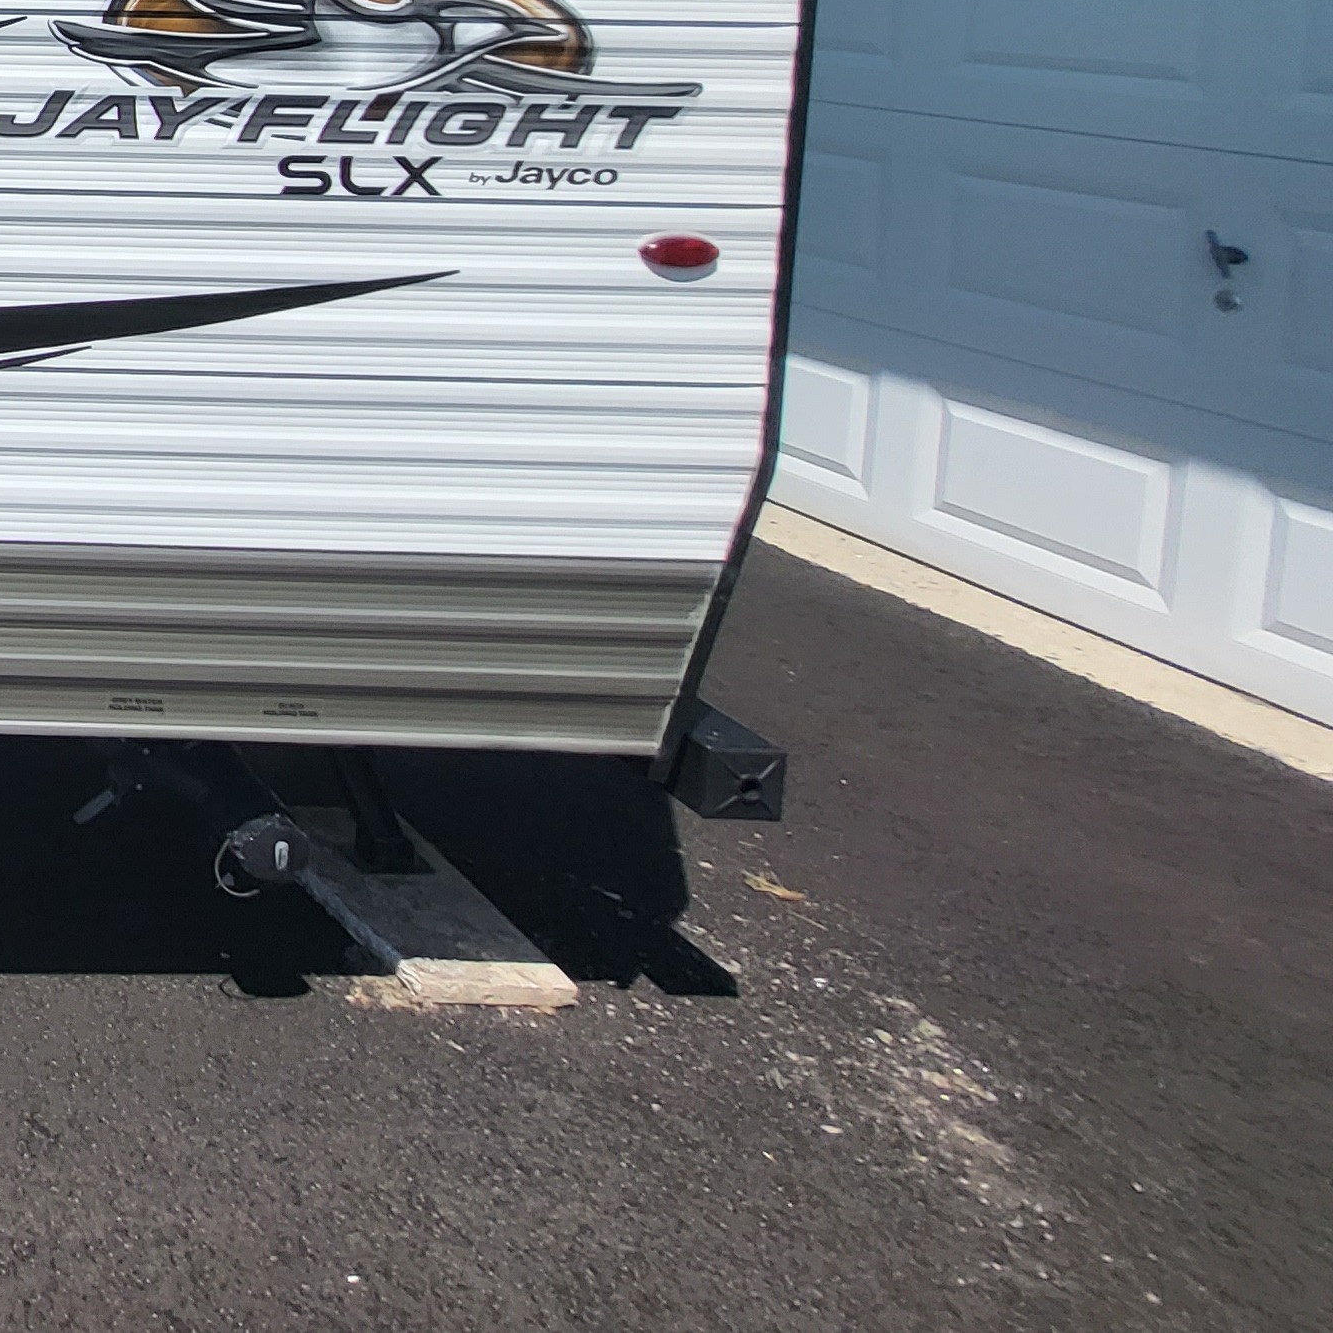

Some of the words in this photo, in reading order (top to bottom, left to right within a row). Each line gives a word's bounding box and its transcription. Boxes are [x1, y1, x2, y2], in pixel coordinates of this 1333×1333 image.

[237, 95, 683, 150] FLIGHT
[277, 155, 443, 196] SLX
[469, 173, 490, 185] by
[495, 161, 618, 190] Jayco
